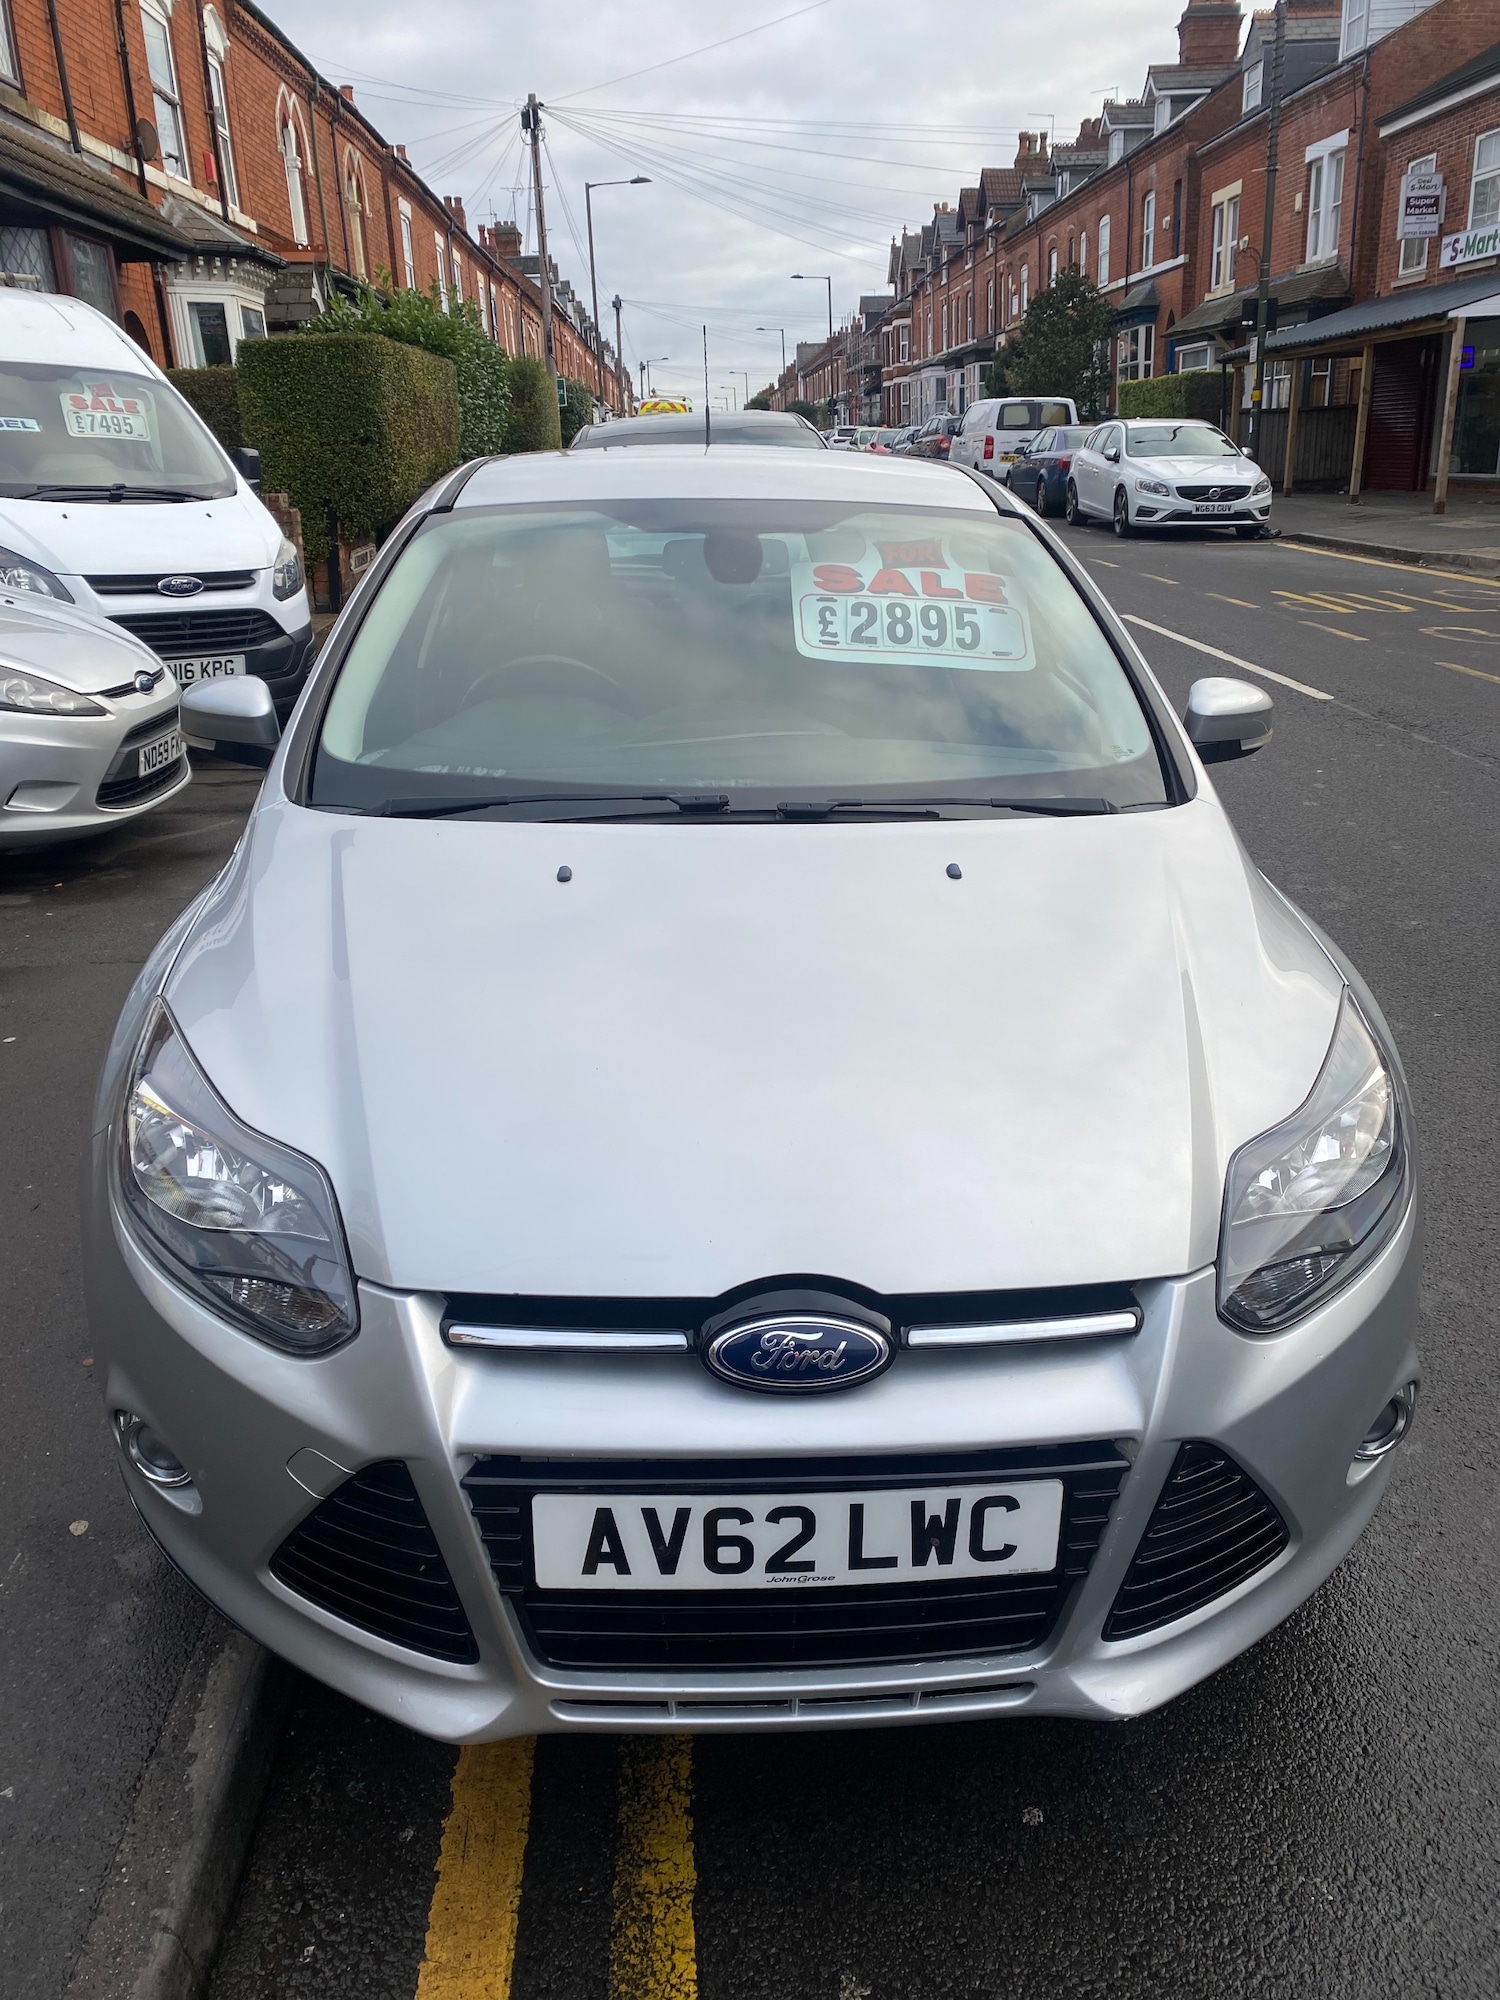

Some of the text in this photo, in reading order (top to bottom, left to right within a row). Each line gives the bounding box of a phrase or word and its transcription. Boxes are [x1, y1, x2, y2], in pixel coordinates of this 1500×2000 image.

[1406, 206, 1437, 214] Market
[1409, 197, 1435, 206] Super
[68, 395, 141, 414] SALE
[75, 414, 134, 435] £7495
[1195, 504, 1215, 513] WG63
[169, 578, 195, 592] Ford
[813, 564, 1009, 605] SALE
[818, 601, 981, 651] £2895
[167, 659, 235, 681] N16 KPG
[143, 740, 169, 772] ND59
[751, 1330, 848, 1372] Ford
[580, 1494, 1022, 1576] AV62 LWC
